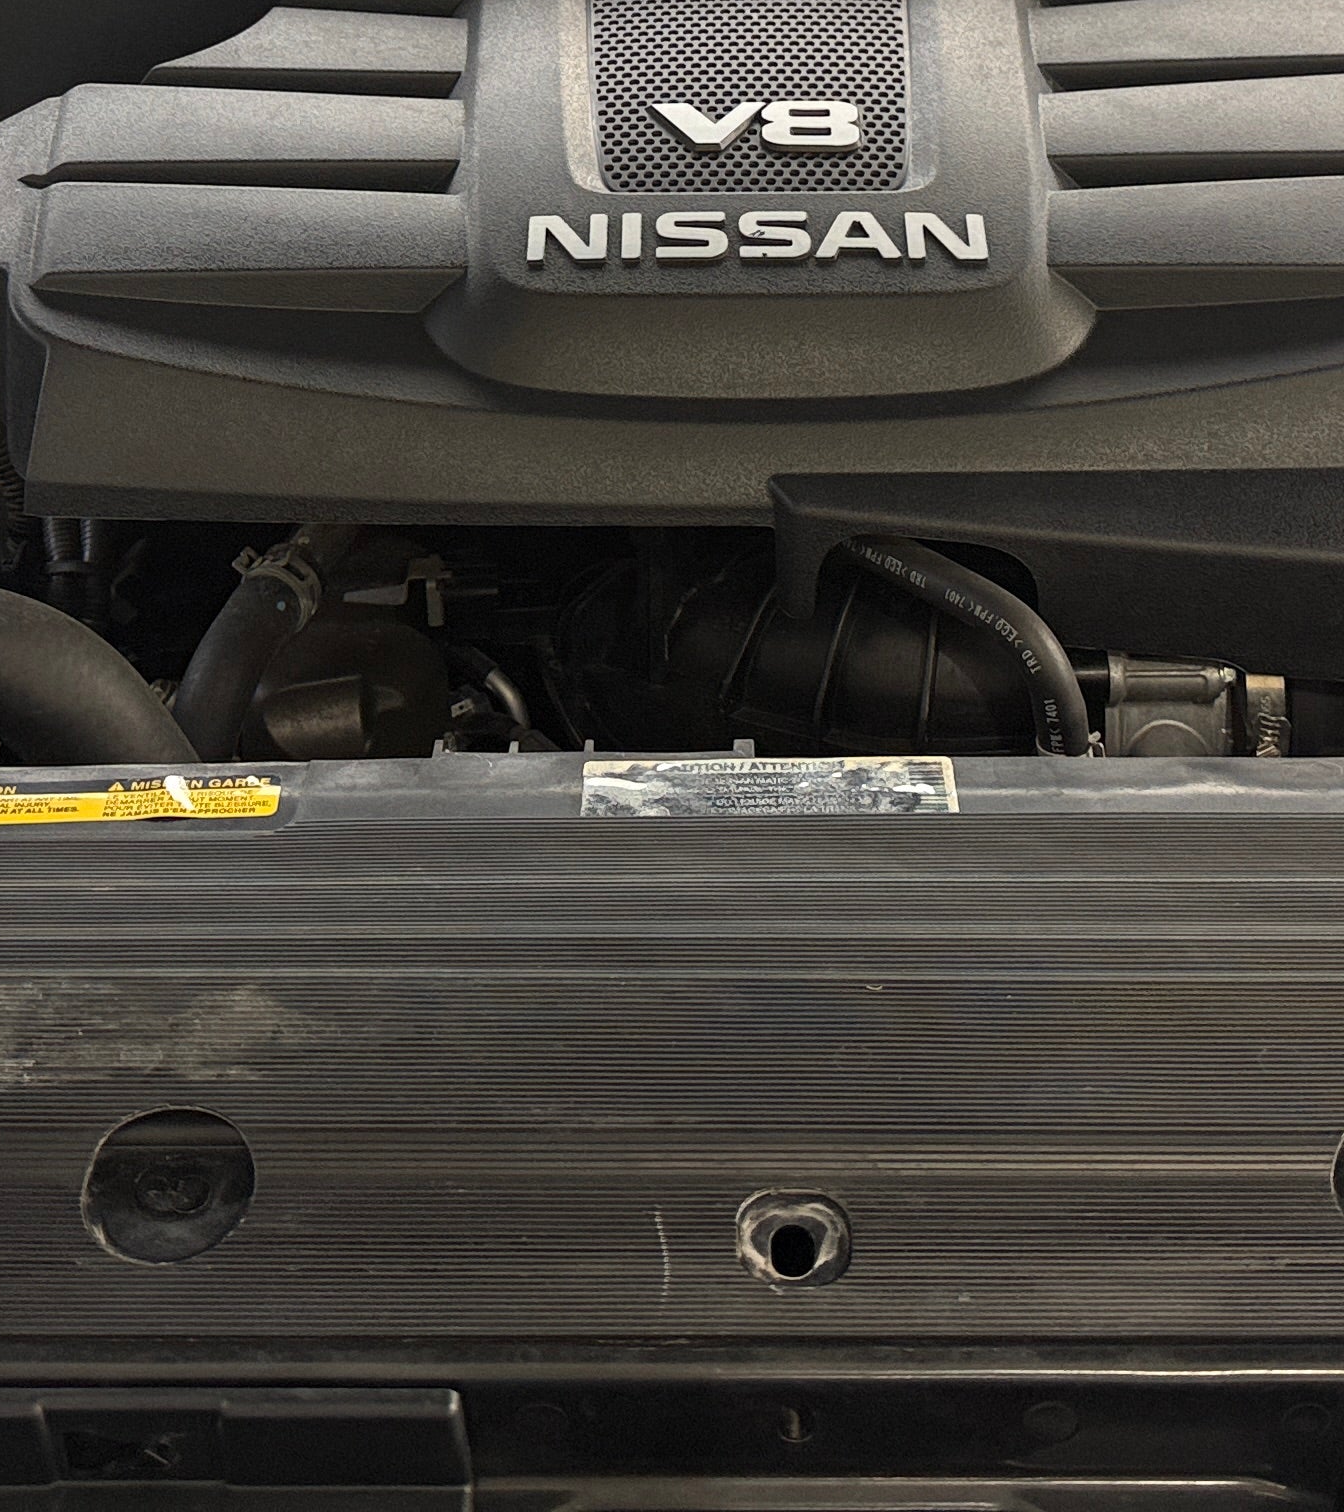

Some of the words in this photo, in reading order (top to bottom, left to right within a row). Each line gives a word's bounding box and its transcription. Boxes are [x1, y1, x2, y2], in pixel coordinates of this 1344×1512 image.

[649, 100, 861, 153] V8
[526, 210, 989, 265] NISSAN
[1021, 649, 1042, 675] TRD
[119, 808, 160, 818] JAMAIS
[190, 807, 256, 815] APPROCHER
